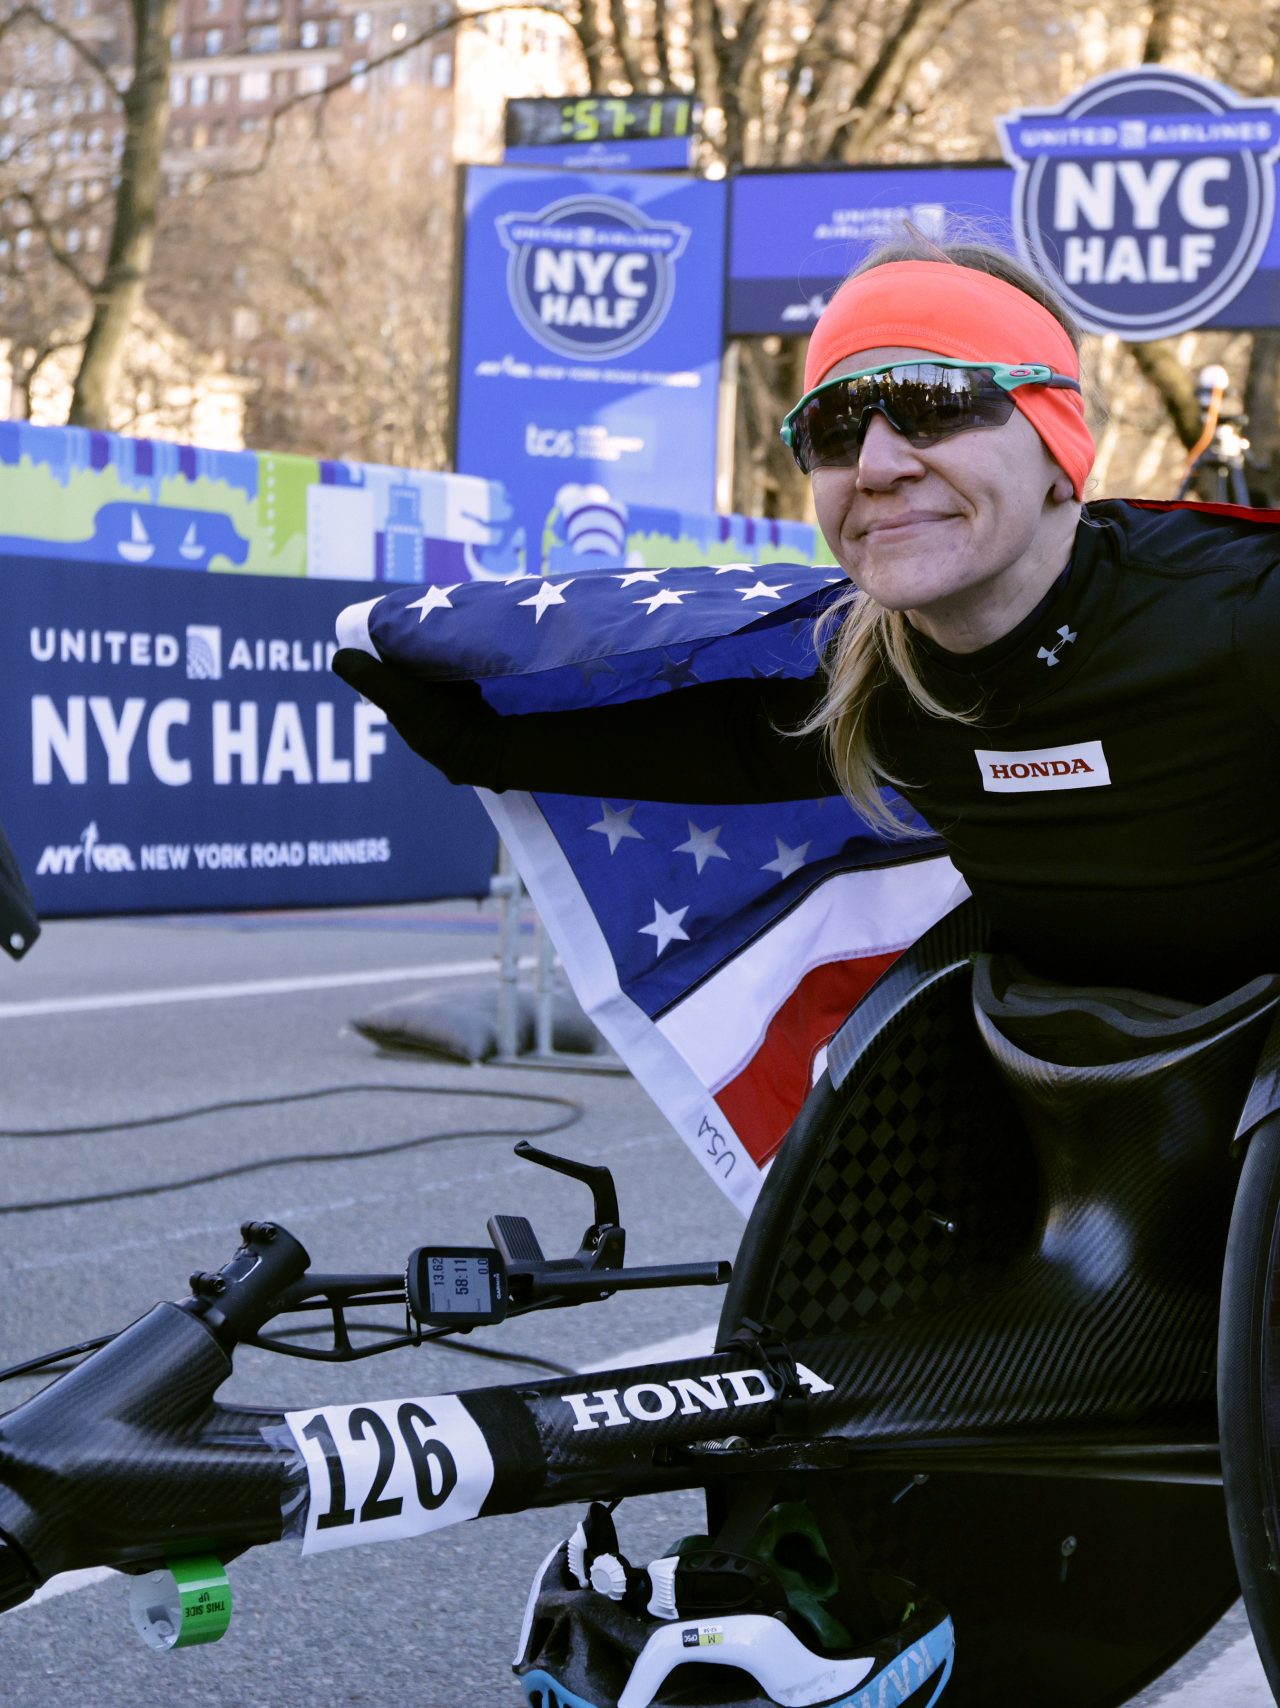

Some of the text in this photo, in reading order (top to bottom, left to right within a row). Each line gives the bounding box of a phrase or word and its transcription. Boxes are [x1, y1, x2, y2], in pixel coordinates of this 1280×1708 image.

[1020, 121, 1272, 148] UNITED AIRLINES
[1054, 157, 1231, 232] NYC
[533, 247, 649, 298] NYC
[1064, 234, 1215, 285] HALF
[541, 294, 639, 328] HALF
[30, 627, 338, 672] UNITED AIRLI
[32, 694, 389, 787] NYC HALF
[990, 758, 1094, 779] HONDA
[141, 845, 190, 870] NEW
[193, 843, 248, 869] YORK
[251, 841, 305, 867] ROAD
[308, 837, 391, 866] RUNNERS
[698, 1115, 736, 1179] USA
[432, 1258, 444, 1286] 13.62
[454, 1260, 469, 1295] 58:11
[478, 1259, 489, 1275] 0.0
[561, 1362, 834, 1431] HONDA
[301, 1401, 457, 1530] 126
[185, 1600, 225, 1617] THIS SIDE
[198, 1592, 210, 1603] UP
[707, 1634, 716, 1644] M
